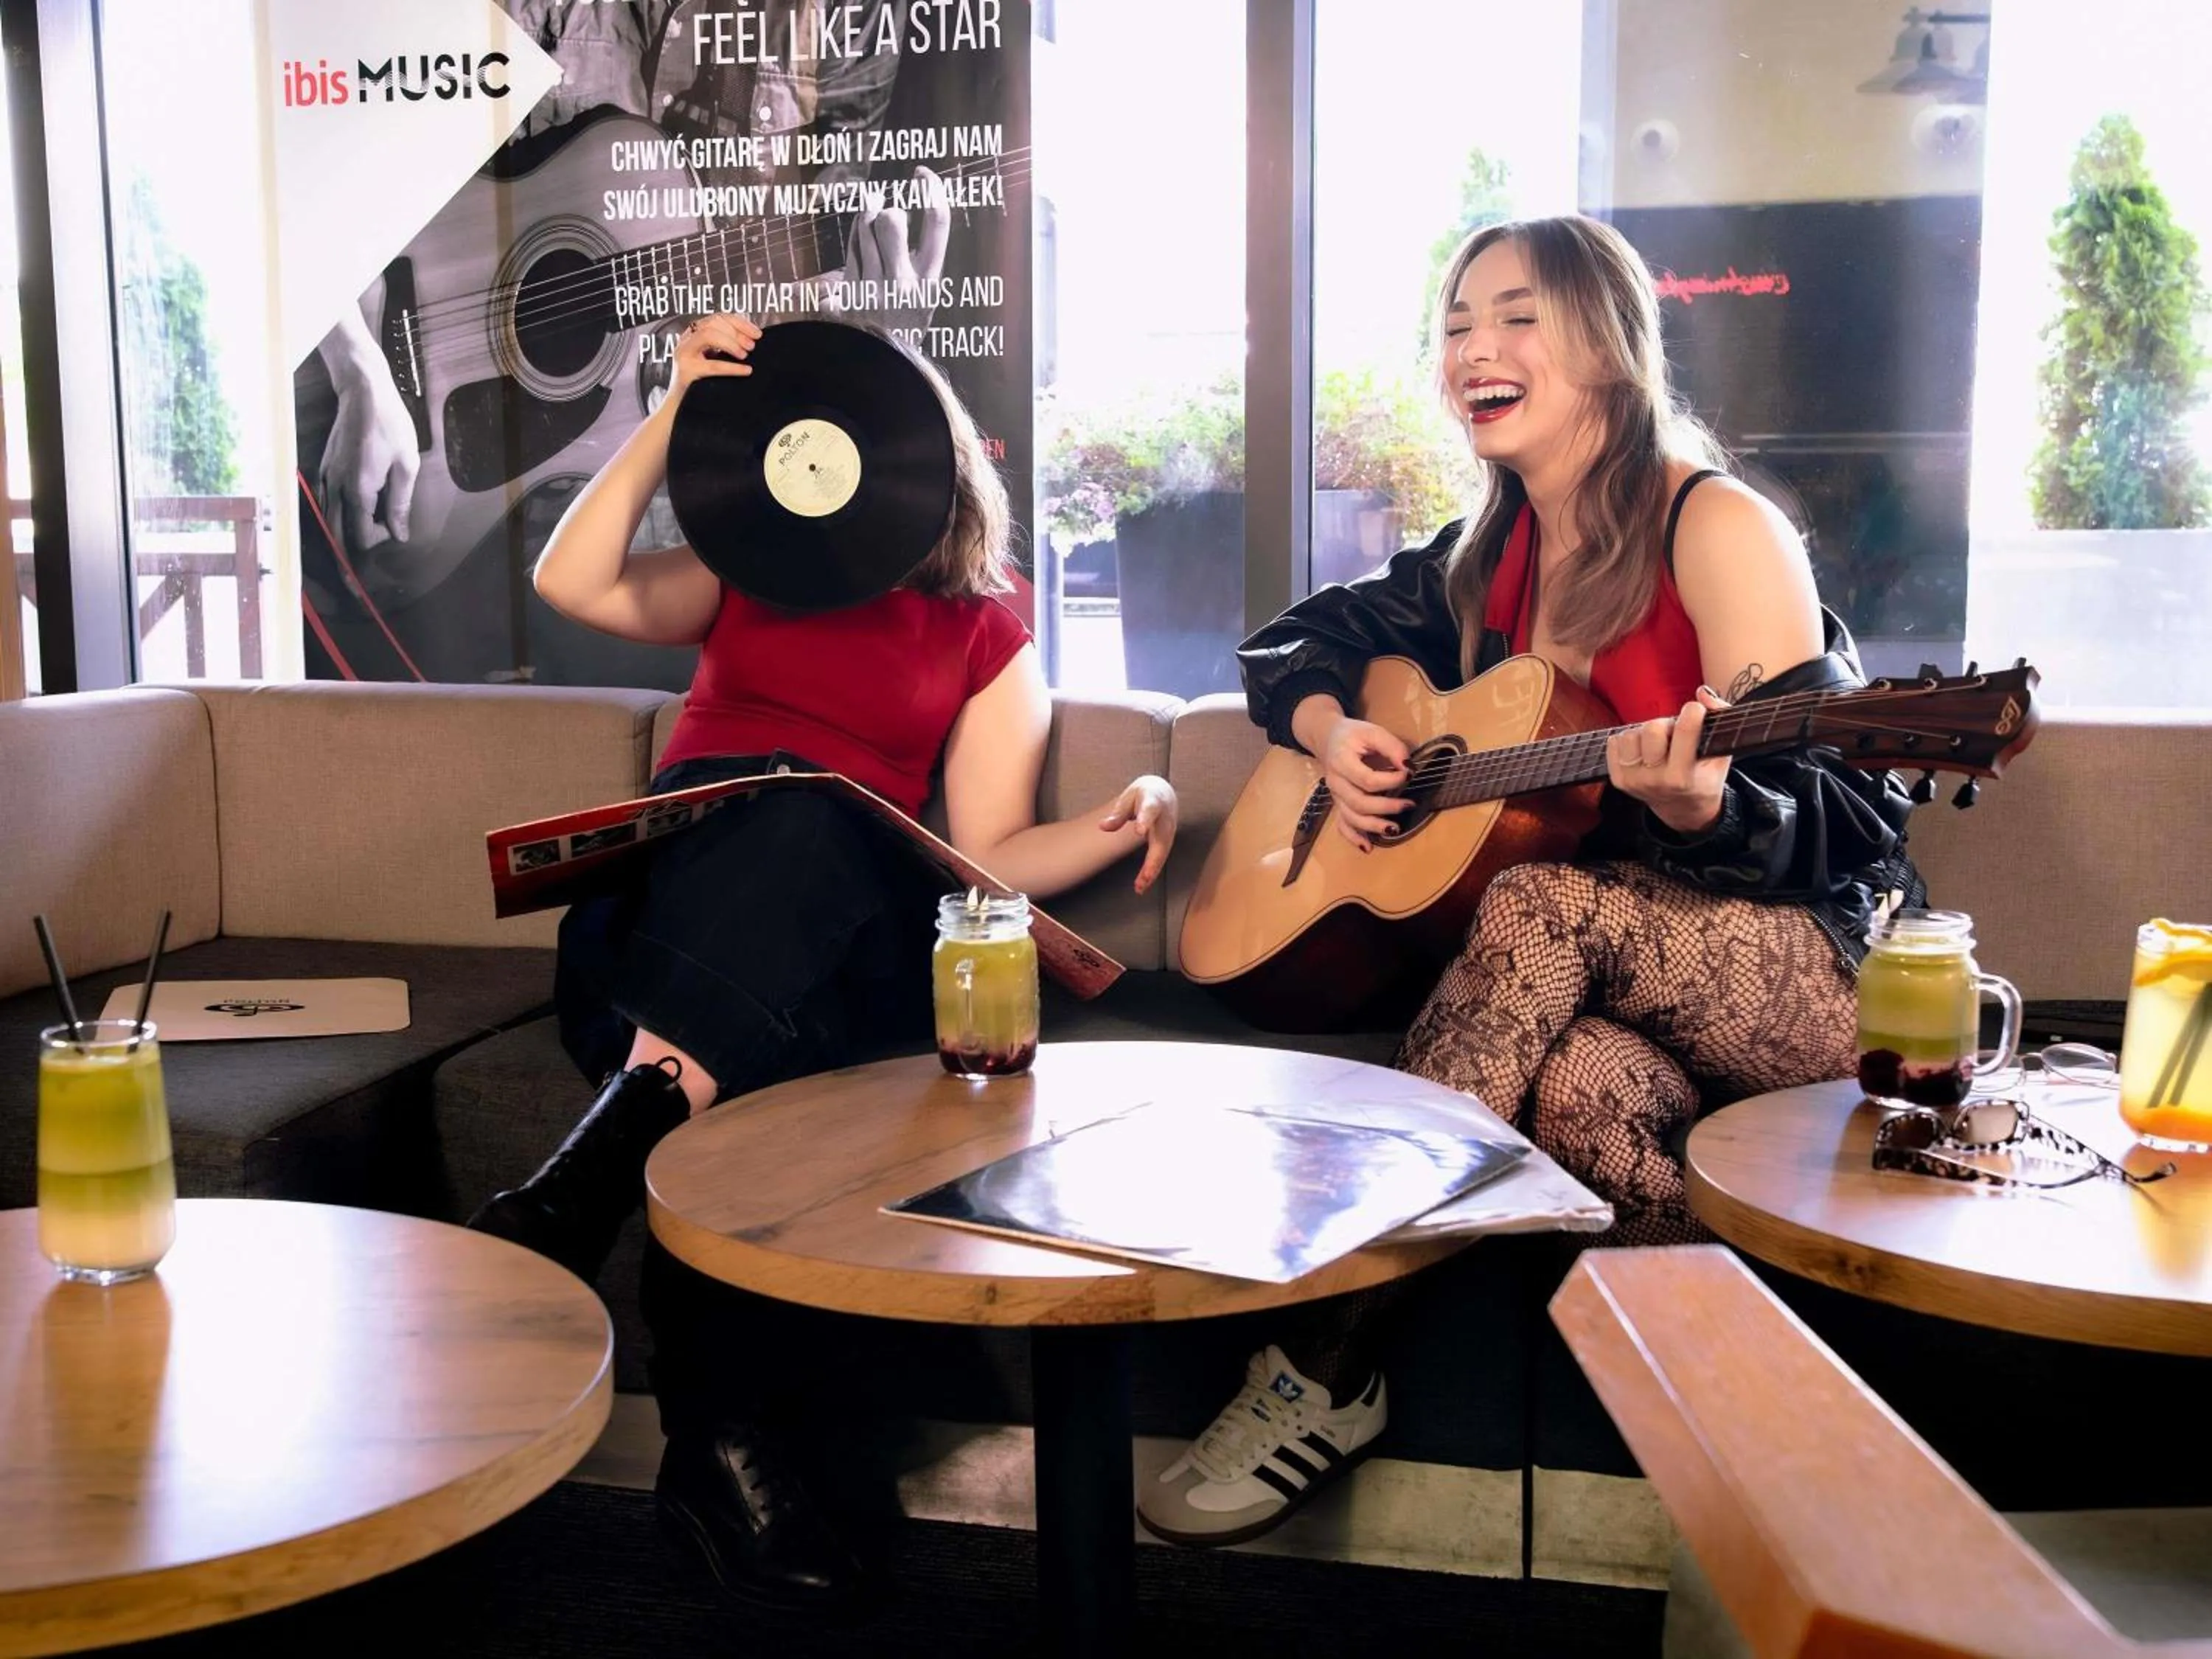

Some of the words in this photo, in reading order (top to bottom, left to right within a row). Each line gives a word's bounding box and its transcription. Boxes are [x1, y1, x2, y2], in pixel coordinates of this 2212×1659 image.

[694, 12, 779, 65] FEEL
[790, 6, 863, 60] LIKE
[874, 4, 898, 55] A
[910, 0, 1001, 53] STAR
[284, 60, 349, 106] ibis
[358, 52, 510, 102] MUSIC
[611, 133, 686, 171] CHWYĆ
[692, 137, 765, 172] GITARĘ
[771, 136, 790, 166] W
[797, 127, 849, 165] DŁOŃ
[858, 132, 863, 161] I
[869, 127, 947, 161] ZAGRAJ
[953, 124, 1002, 157] NAM
[603, 183, 657, 220] SWÓJ
[664, 185, 768, 218] ULUBIONY
[616, 285, 668, 316] GRAB
[675, 284, 714, 314] THE
[720, 282, 793, 313] GUITAR
[800, 282, 819, 312] IN
[826, 279, 878, 311] YOUR
[884, 277, 953, 310] HANDS
[959, 276, 1004, 307] AND
[928, 326, 1004, 357] TRACK!
[778, 431, 810, 466] POLTON
